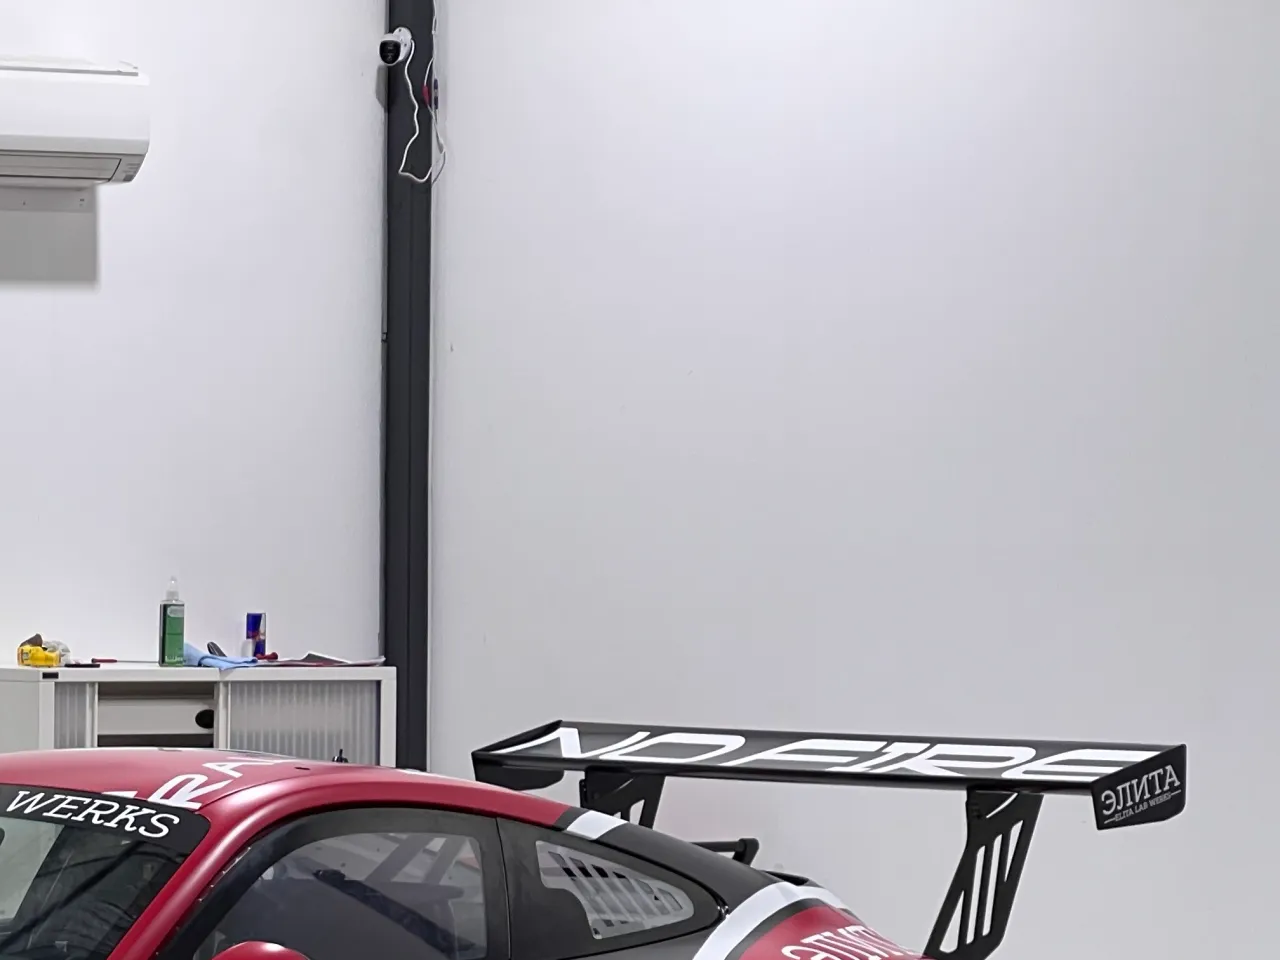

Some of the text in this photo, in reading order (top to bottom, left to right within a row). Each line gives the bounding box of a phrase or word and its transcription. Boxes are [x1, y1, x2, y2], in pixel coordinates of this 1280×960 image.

[497, 726, 1159, 780] NO FIRE
[7, 791, 181, 838] WERKS
[1101, 765, 1180, 815] ЭЛИТА
